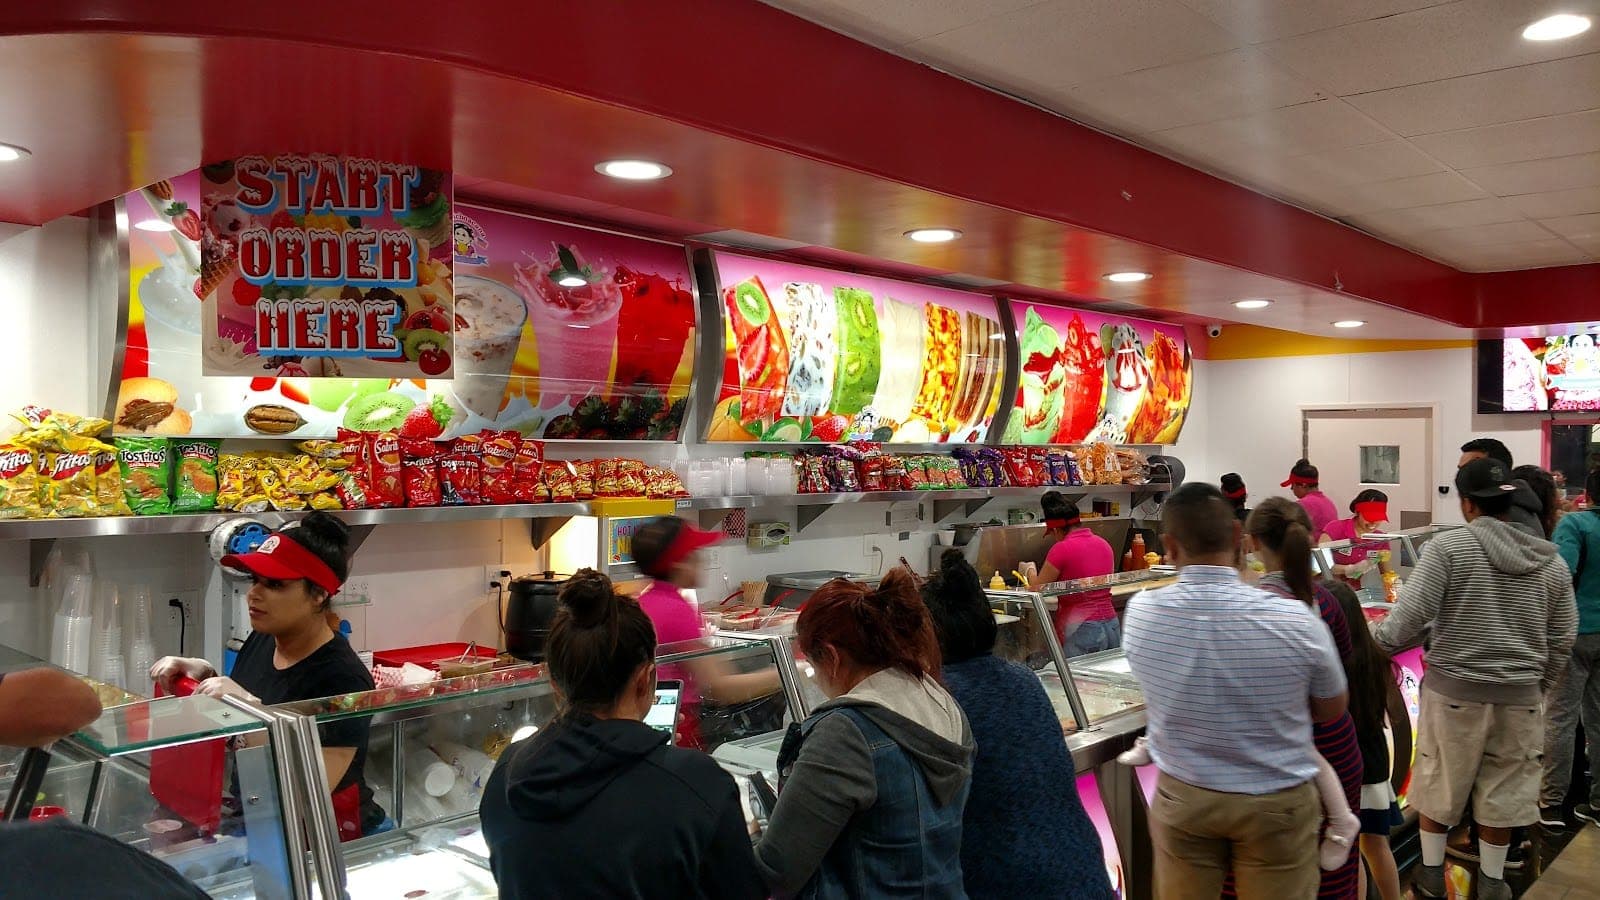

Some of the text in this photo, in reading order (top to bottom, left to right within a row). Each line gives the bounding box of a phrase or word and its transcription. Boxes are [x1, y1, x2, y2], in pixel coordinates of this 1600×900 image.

[235, 155, 420, 214] START
[239, 228, 418, 286] ORDER
[257, 298, 403, 357] HERE
[0, 451, 33, 473] ritos
